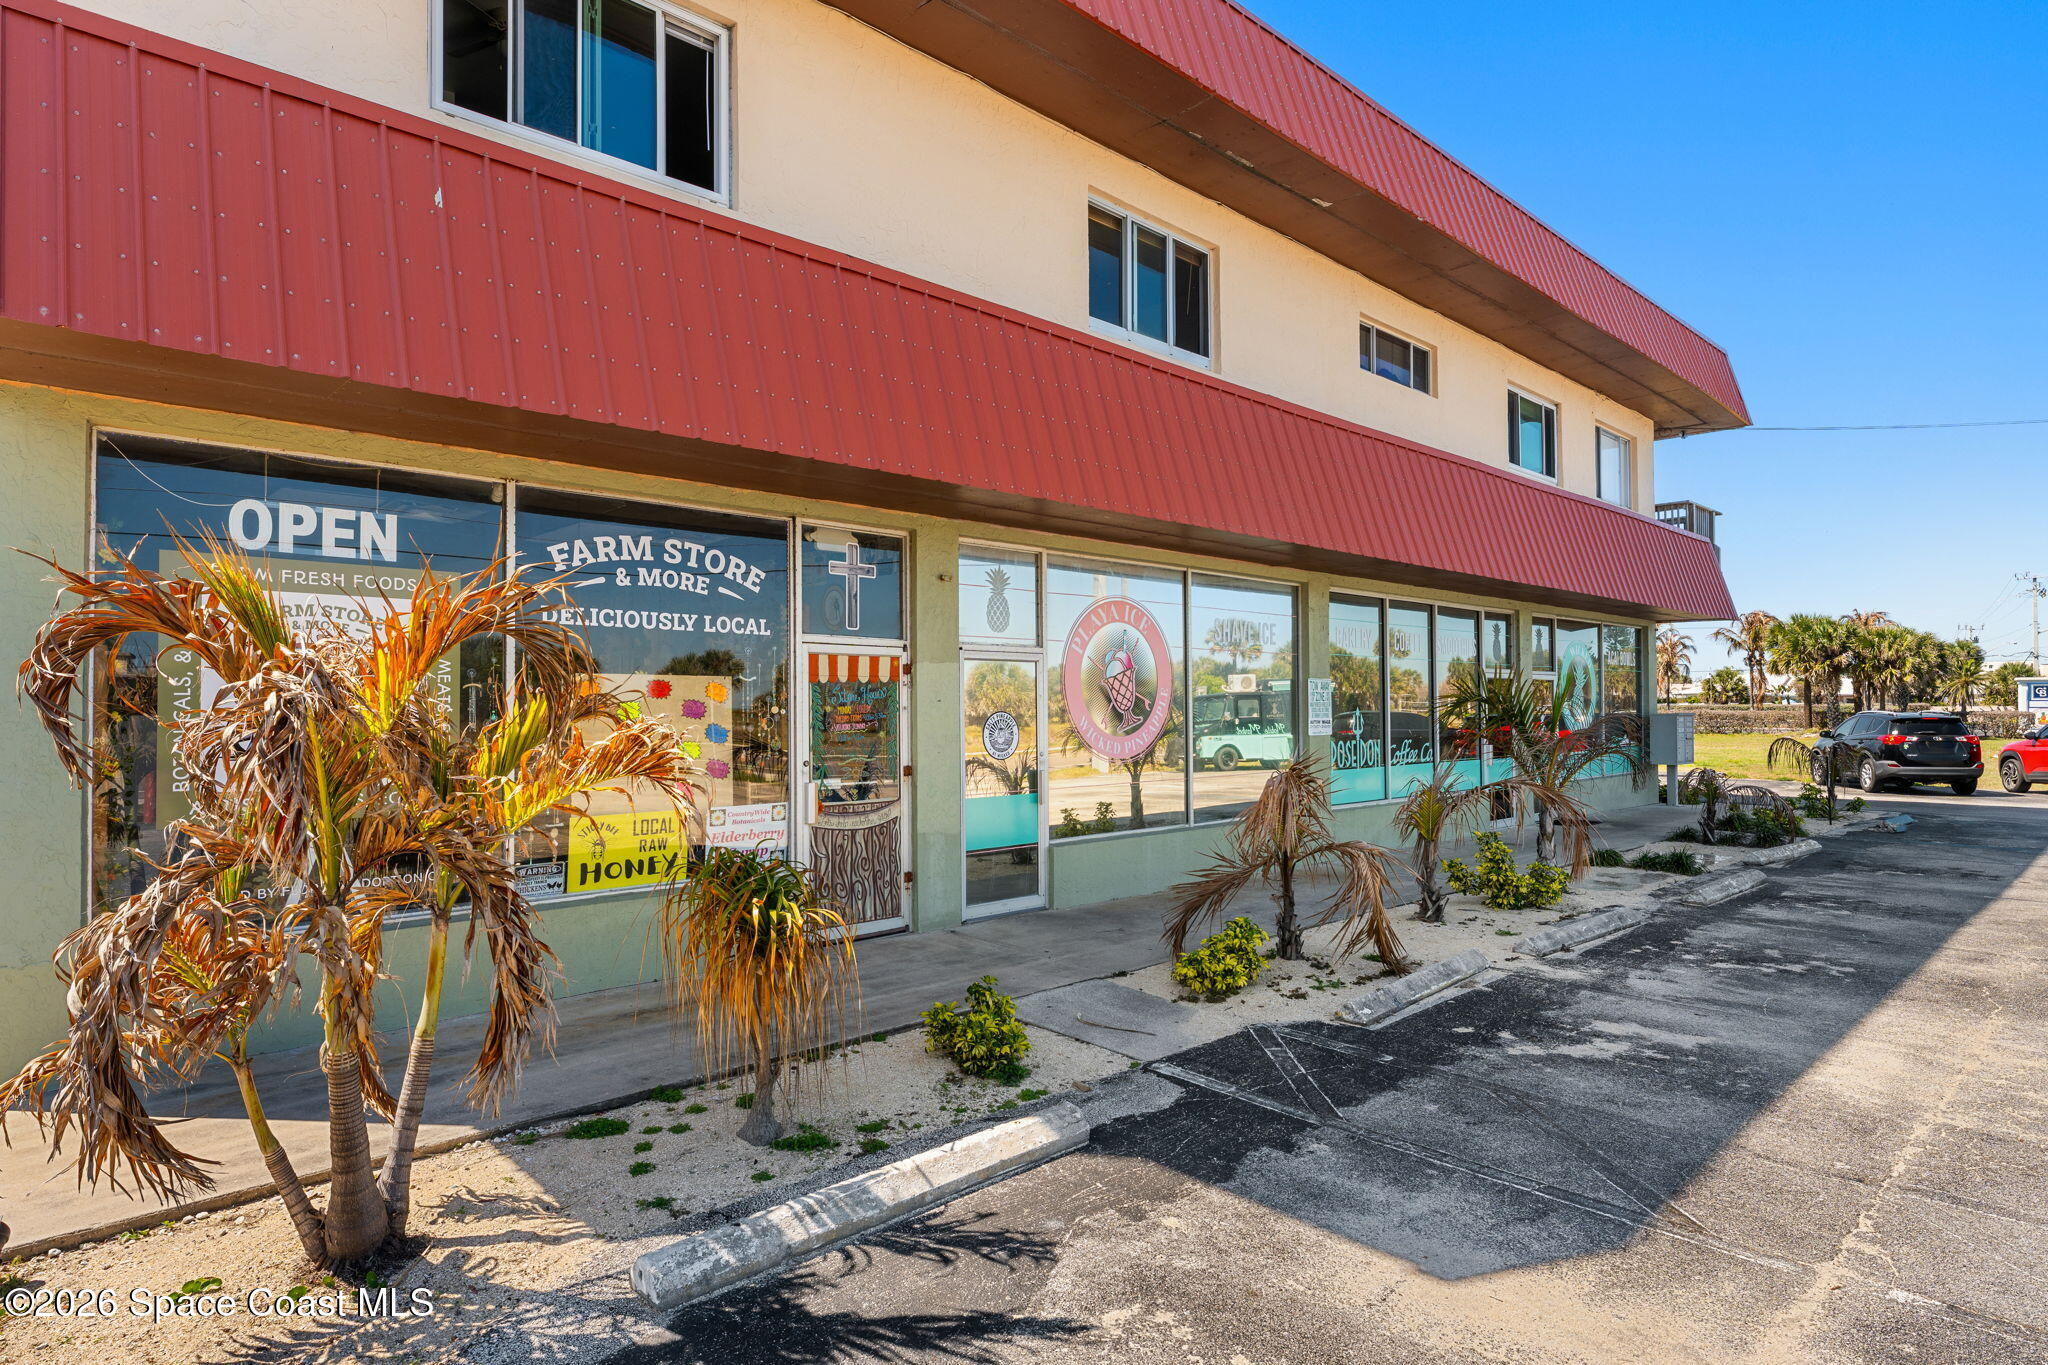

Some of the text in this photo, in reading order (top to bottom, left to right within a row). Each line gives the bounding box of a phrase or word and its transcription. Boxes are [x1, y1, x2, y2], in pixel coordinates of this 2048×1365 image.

[228, 499, 397, 562] OPEN
[547, 535, 766, 593] FARM STORE
[281, 569, 345, 587] FRESH
[353, 575, 416, 591] FOODS
[616, 567, 710, 595] & MORE
[540, 604, 771, 636] DELICIOUSLY LOCAL
[1071, 603, 1152, 654] PLAYA ICE
[1258, 622, 1277, 645] ICE
[174, 650, 192, 663] &
[1080, 687, 1169, 755] WICKED PINEAPPLE
[1330, 738, 1381, 769] POSEIDON
[1389, 739, 1419, 766] Coffee
[633, 817, 675, 837] LOCAL
[711, 828, 785, 845] Elderberry
[639, 837, 668, 853] RAW
[517, 865, 558, 877] WARNING
[579, 852, 678, 886] HONEY
[257, 885, 276, 899] BY
